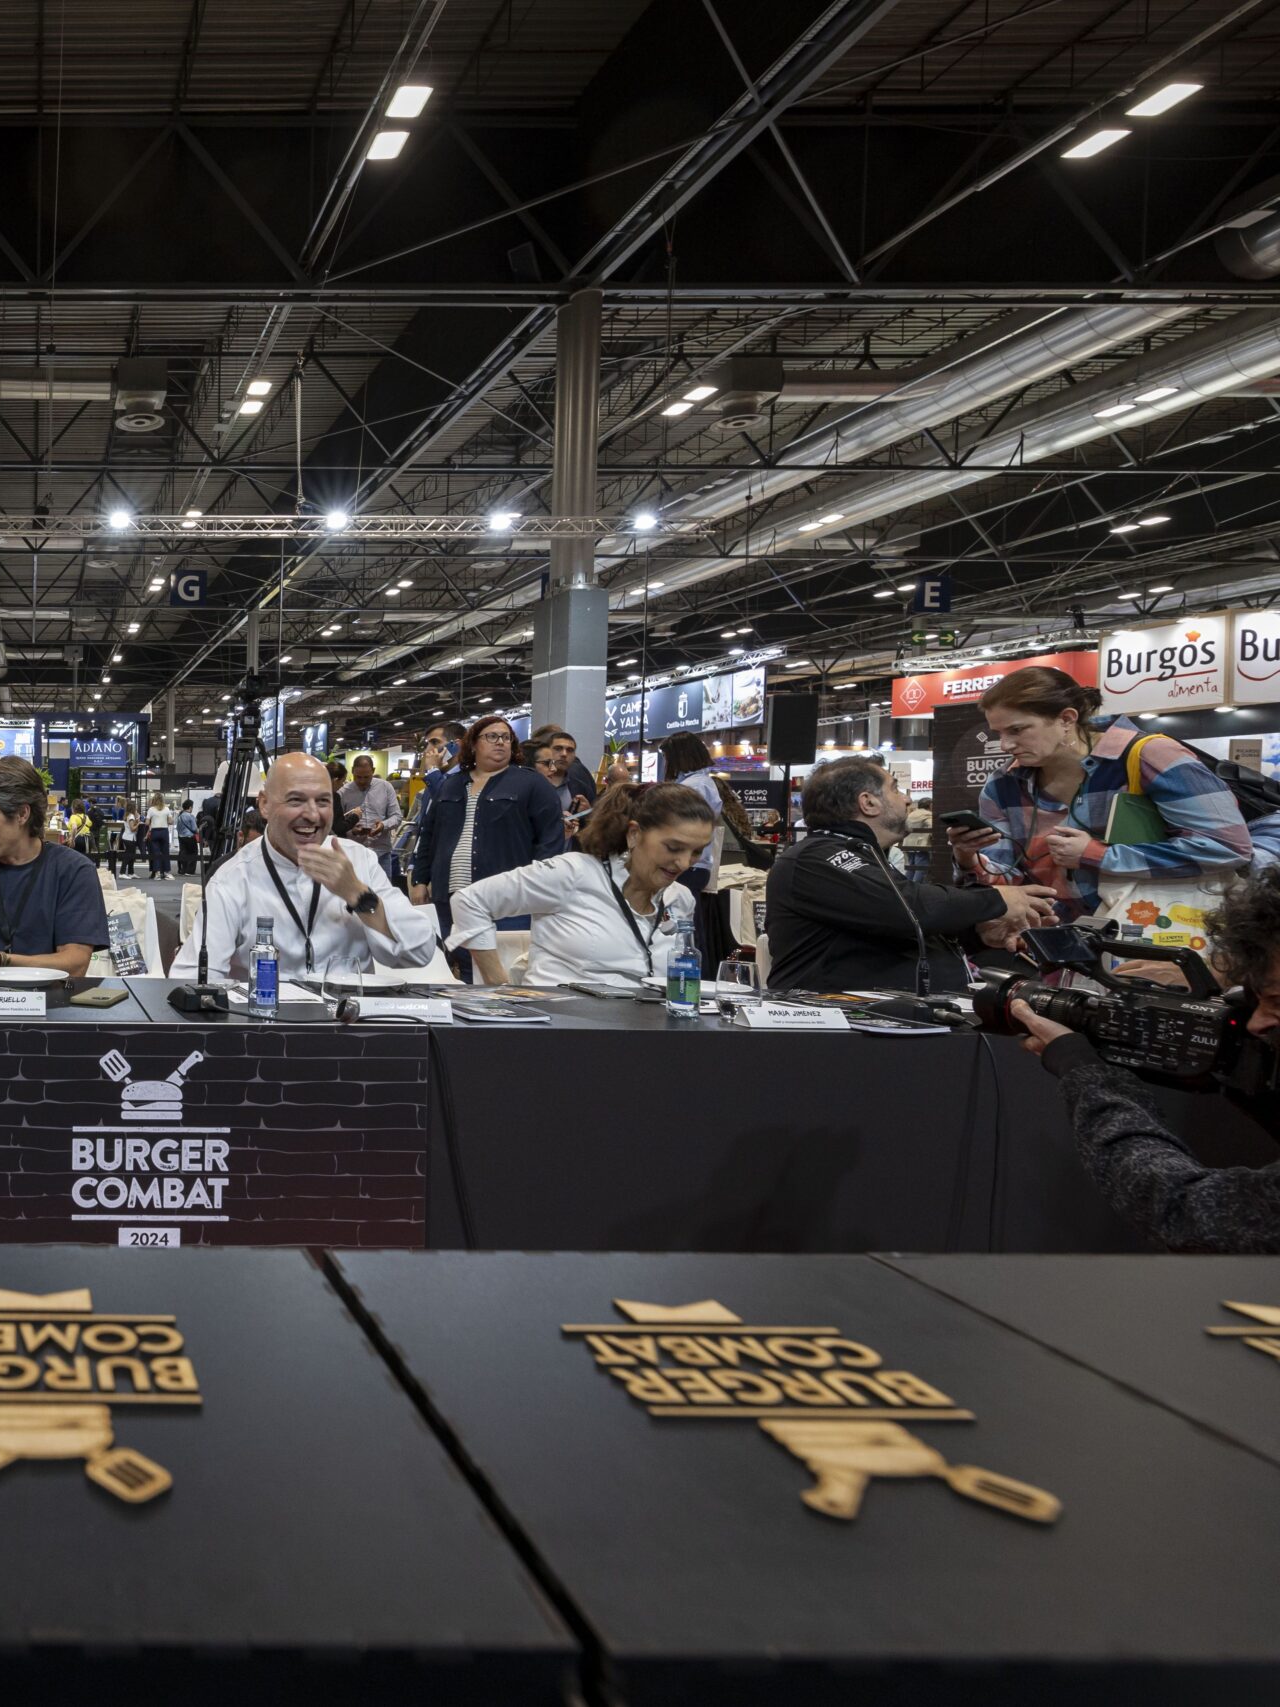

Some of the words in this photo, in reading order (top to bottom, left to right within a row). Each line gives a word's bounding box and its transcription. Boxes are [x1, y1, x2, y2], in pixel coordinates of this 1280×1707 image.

[178, 575, 200, 601] G
[924, 581, 941, 607] E
[1107, 641, 1216, 681] Burgos
[1168, 677, 1218, 698] alimenta
[75, 742, 122, 752] ADIANO
[967, 758, 1009, 771] BURG
[1181, 1003, 1219, 1013] SONY
[1191, 1034, 1218, 1046] ZULU
[72, 1138, 230, 1172] BURGER
[72, 1177, 230, 1209] COMBAT
[130, 1232, 170, 1247] 2024
[585, 1334, 883, 1369] COMBAT
[609, 1366, 956, 1406] BURGER
